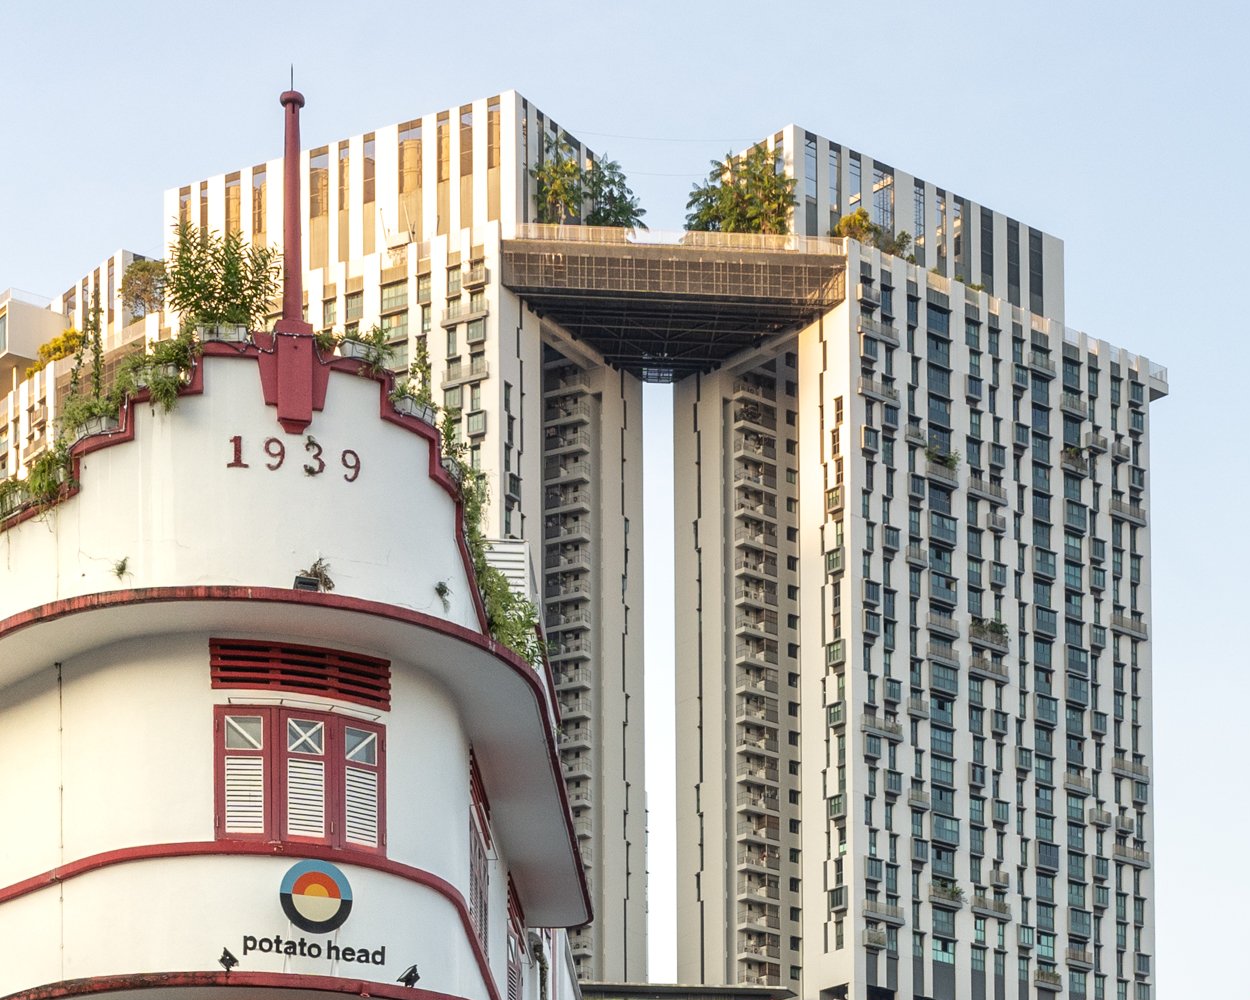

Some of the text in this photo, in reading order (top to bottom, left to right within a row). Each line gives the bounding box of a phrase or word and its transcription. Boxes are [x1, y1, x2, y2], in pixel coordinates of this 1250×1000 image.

[226, 435, 361, 483] 1939
[242, 935, 386, 966] potato head
